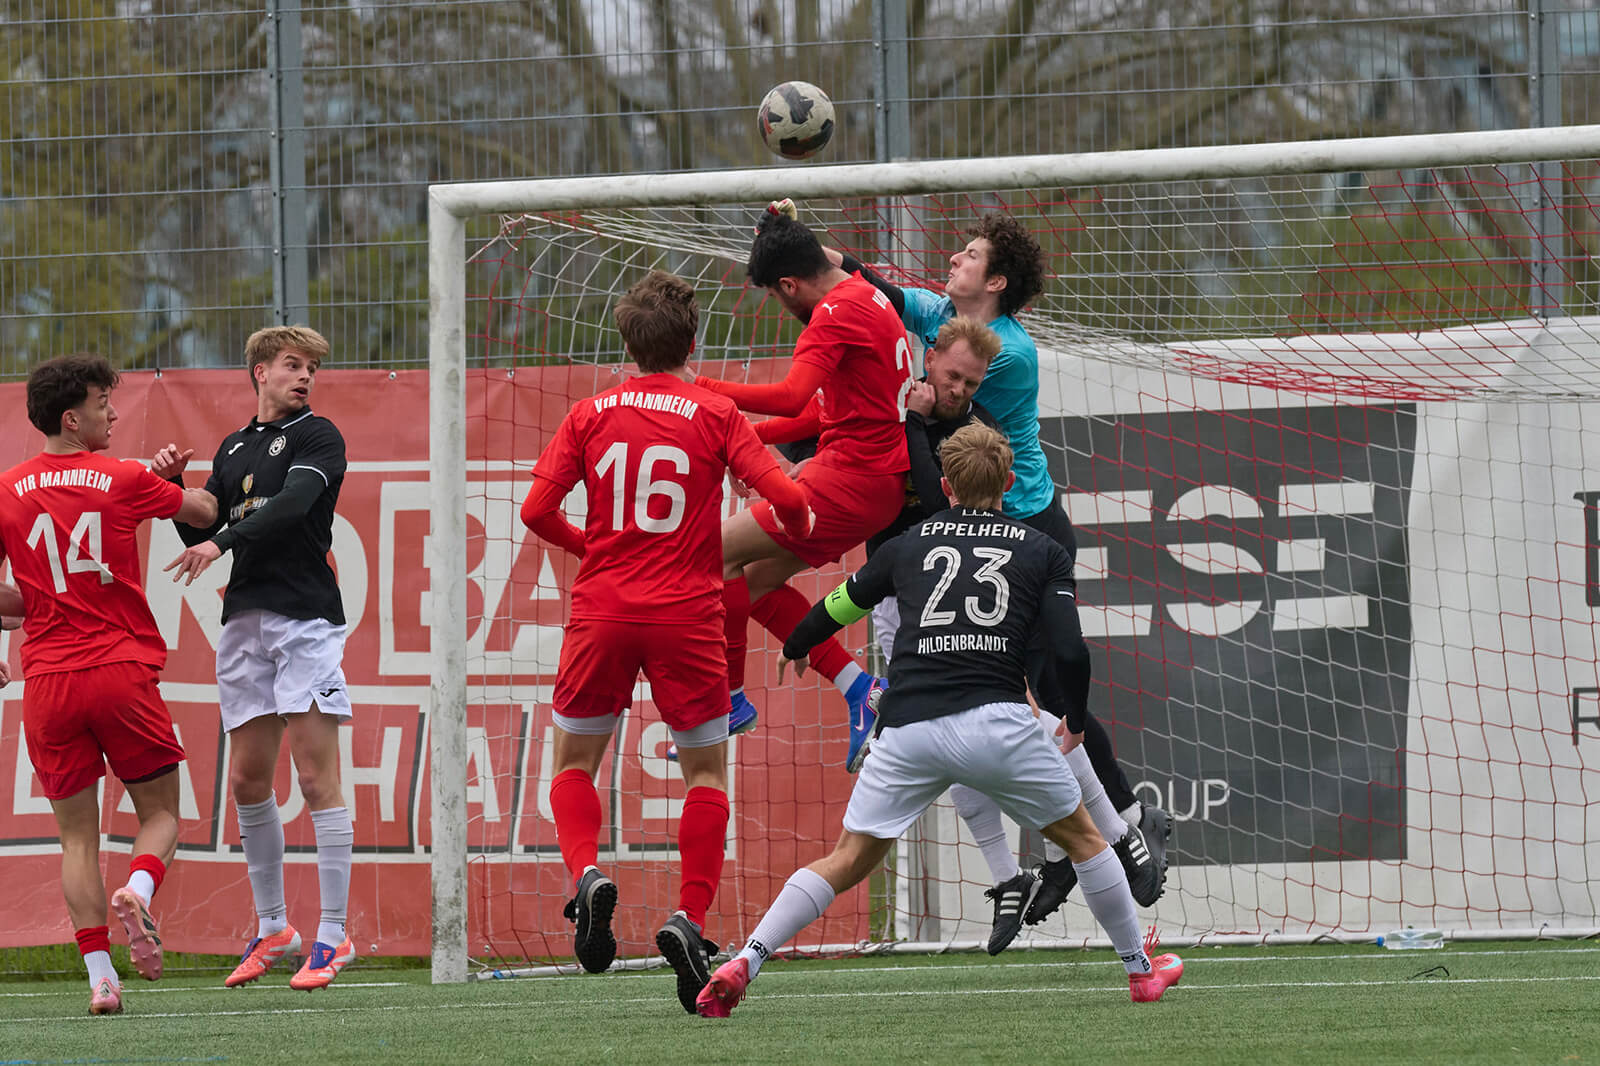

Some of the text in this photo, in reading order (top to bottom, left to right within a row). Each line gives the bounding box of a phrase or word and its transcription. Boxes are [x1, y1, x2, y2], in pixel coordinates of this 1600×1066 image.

[620, 391, 699, 421] MANNHEIM
[39, 468, 113, 493] MANNHEIM
[594, 441, 690, 533] 16
[920, 521, 1026, 541] EPPELHEIM
[26, 511, 114, 594] 14
[919, 545, 1013, 628] 23
[917, 634, 1009, 655] HILDENBRANDT
[1131, 778, 1231, 822] OUP
